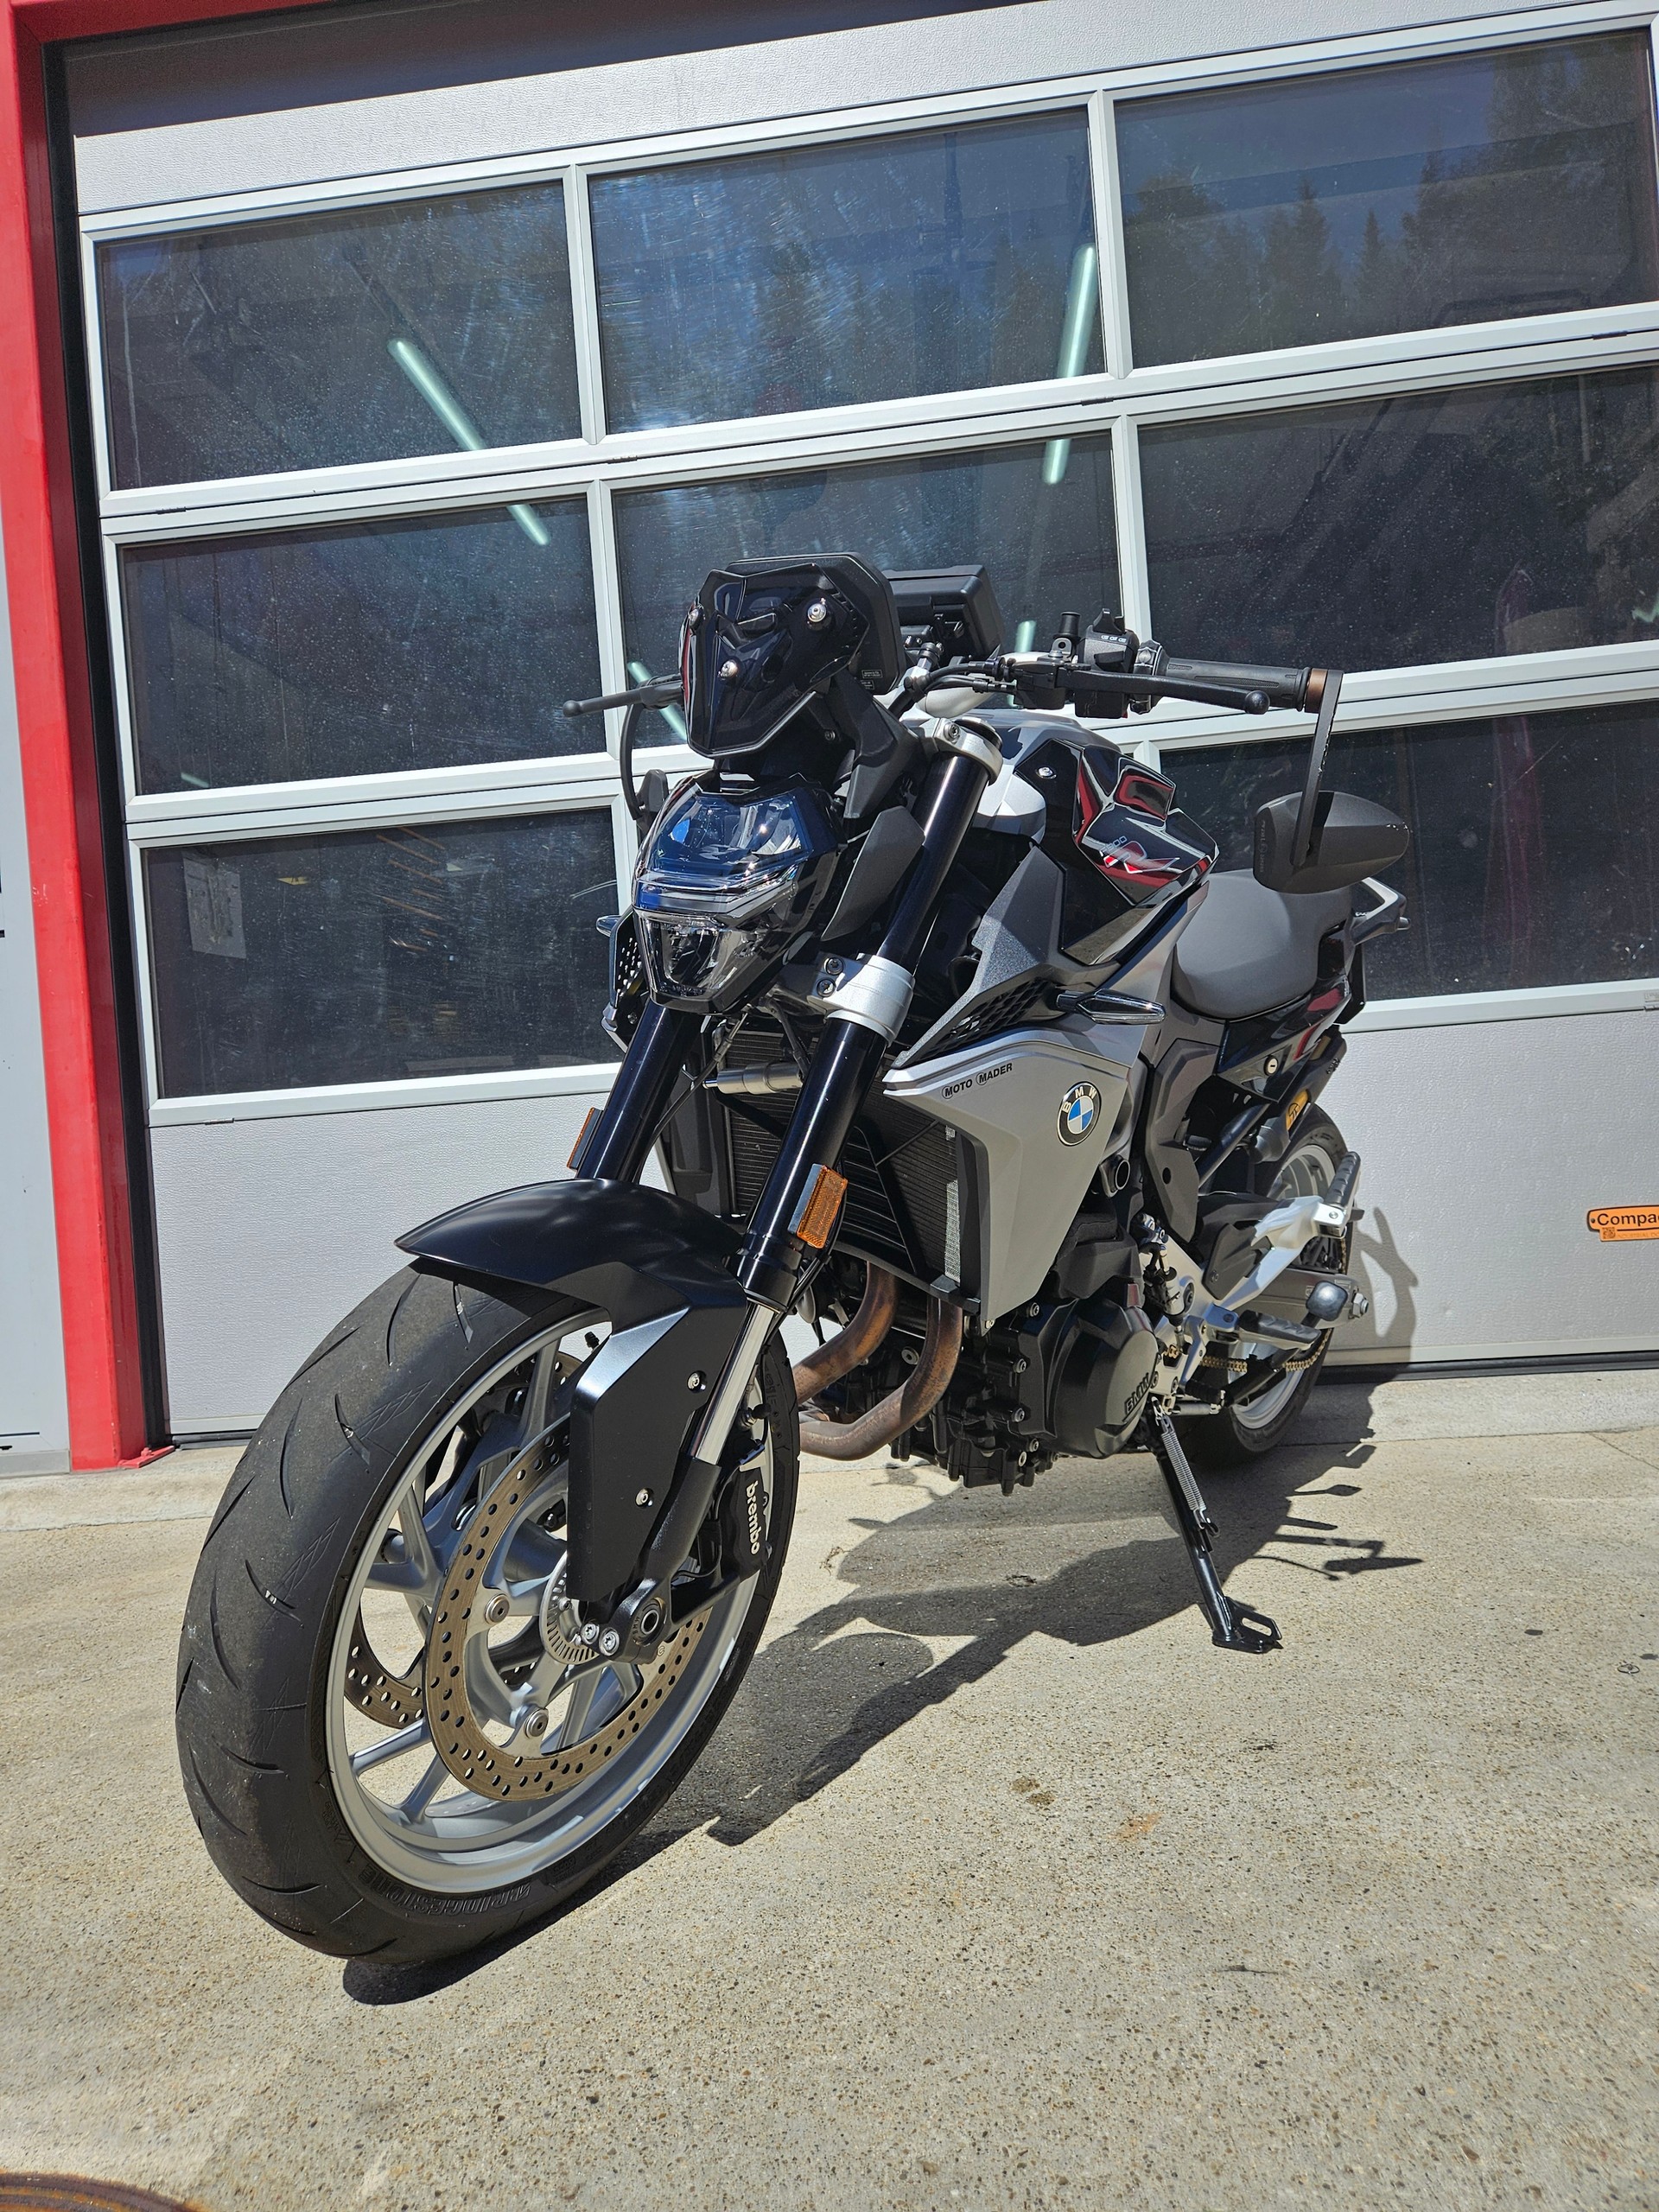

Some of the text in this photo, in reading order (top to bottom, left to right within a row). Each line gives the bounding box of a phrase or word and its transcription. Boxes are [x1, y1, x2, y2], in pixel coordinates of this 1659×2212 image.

[942, 1063, 1013, 1099] MOTO MADER
[1061, 1086, 1097, 1114] BMW
[1597, 1212, 1659, 1227] Compa
[1124, 1372, 1149, 1414] BMW
[747, 1480, 761, 1554] brembo
[358, 1863, 531, 1916] BRIDGESTONE
